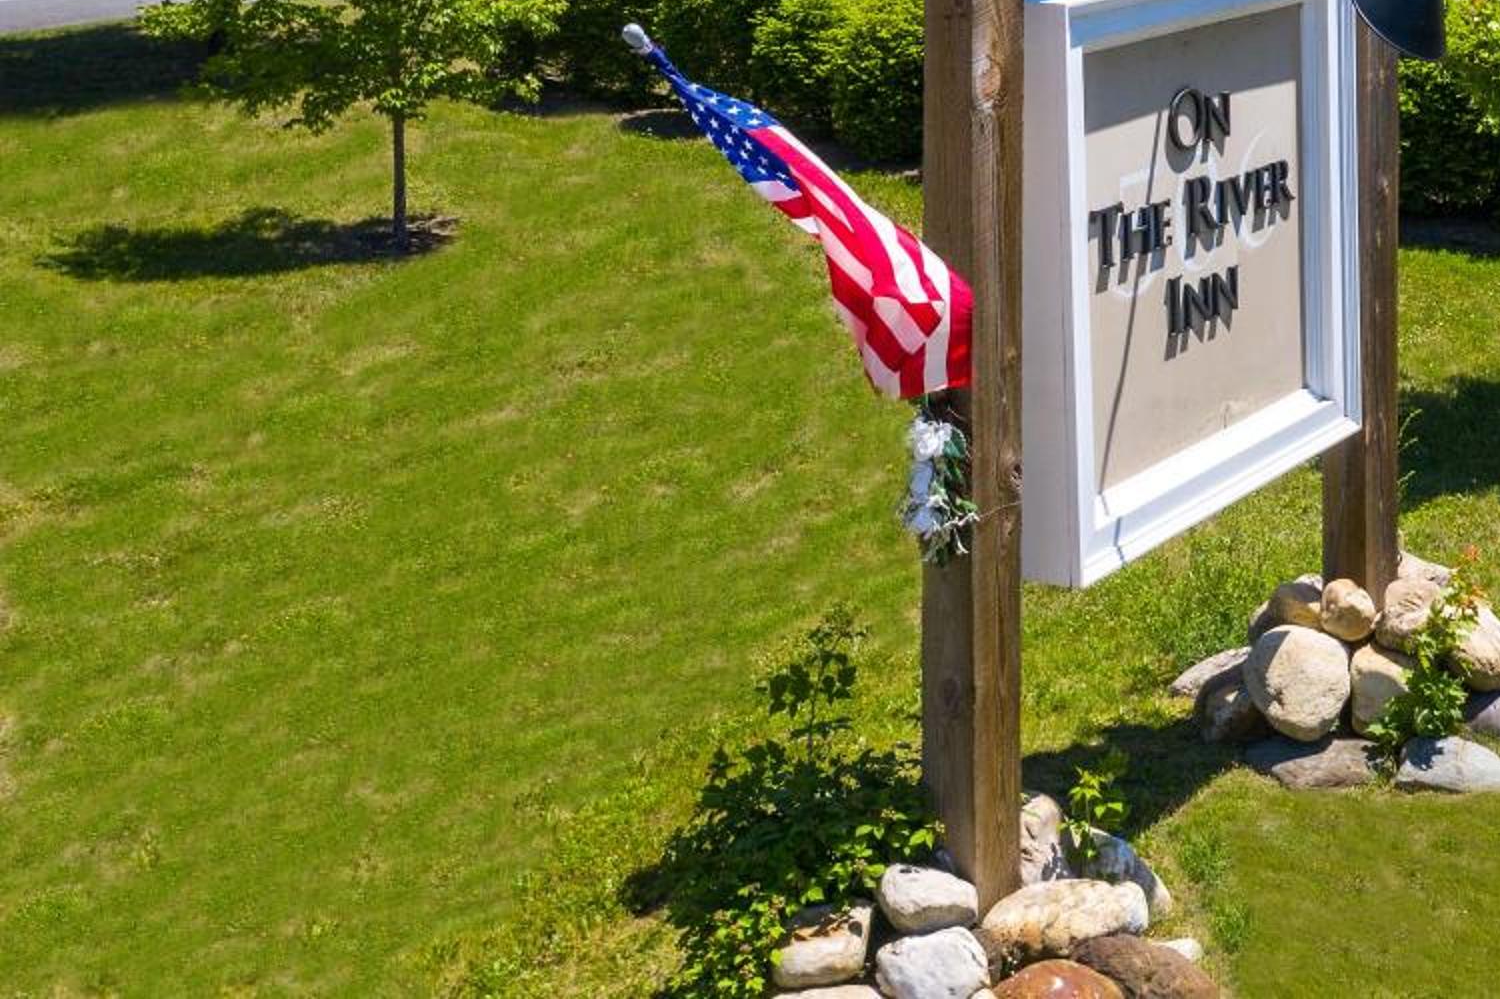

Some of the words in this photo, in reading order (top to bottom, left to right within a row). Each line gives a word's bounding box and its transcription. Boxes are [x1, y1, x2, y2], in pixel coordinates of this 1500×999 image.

[1167, 87, 1232, 151] ON
[1087, 199, 1174, 269] THE
[1184, 159, 1296, 238] RIVER
[1165, 264, 1239, 335] INN
